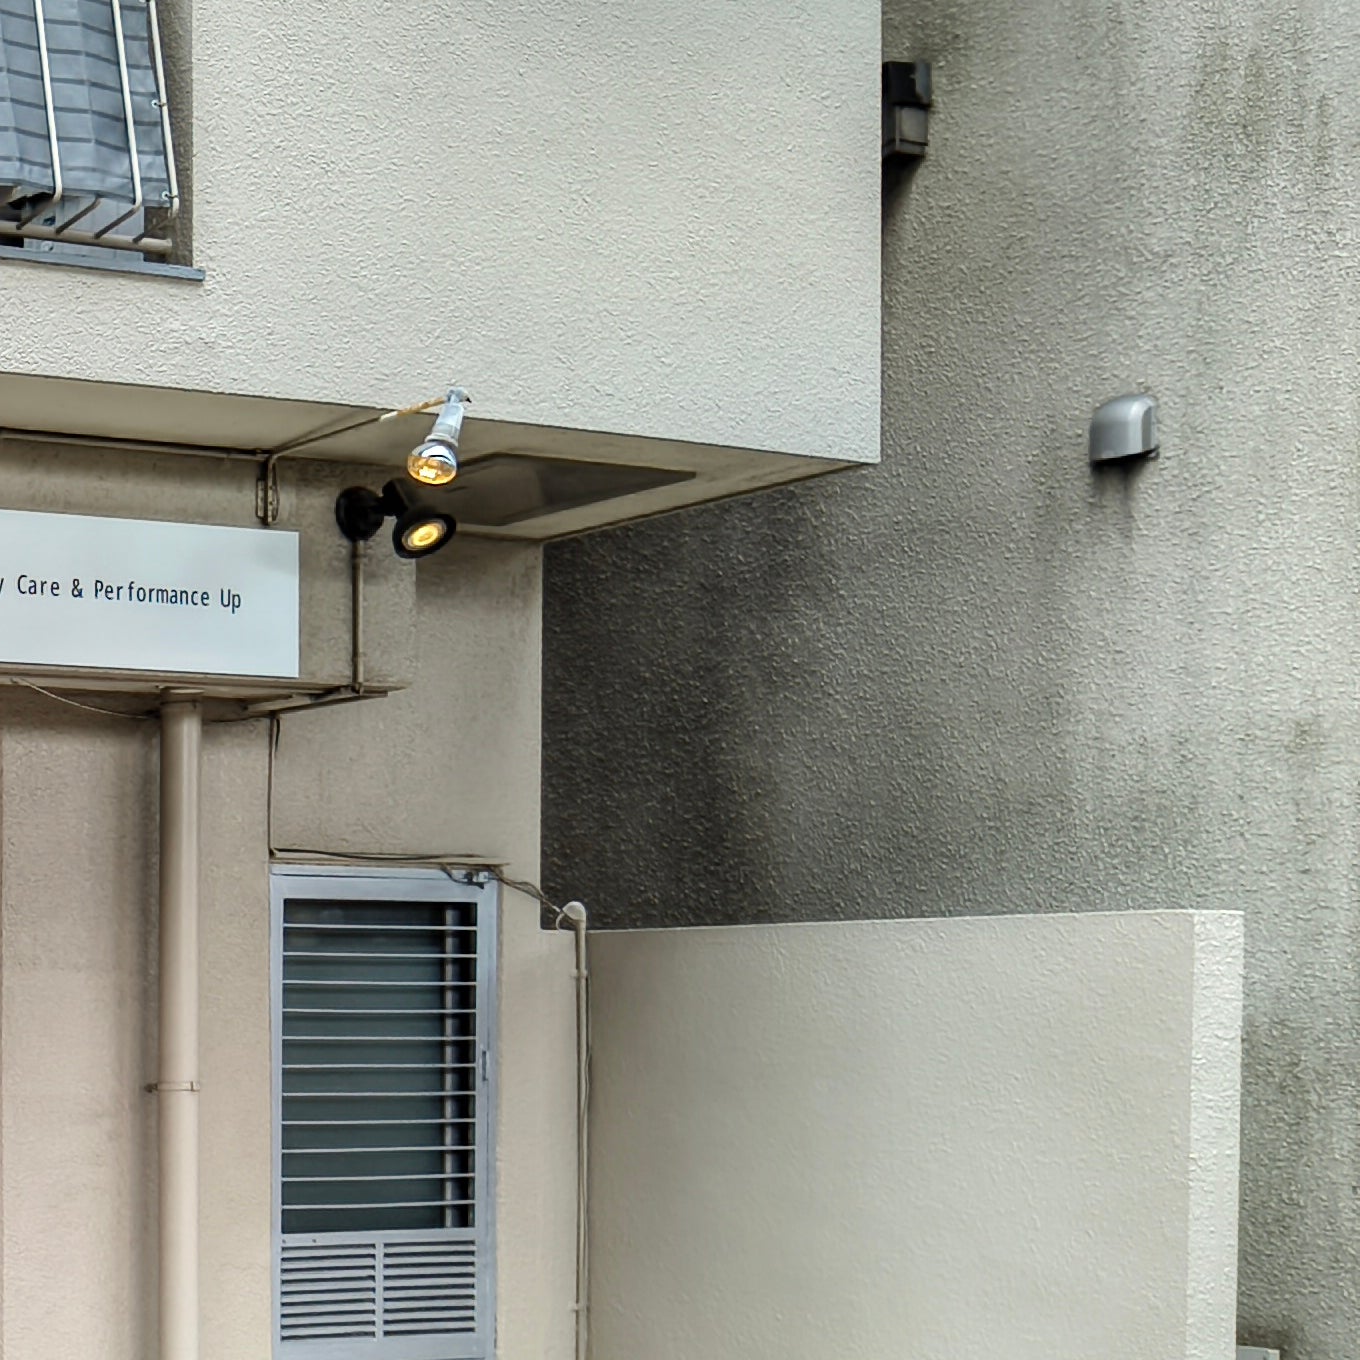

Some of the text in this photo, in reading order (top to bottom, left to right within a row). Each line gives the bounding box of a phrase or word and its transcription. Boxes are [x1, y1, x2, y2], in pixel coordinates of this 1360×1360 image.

[17, 574, 60, 597] Care
[72, 579, 84, 599] &
[94, 580, 211, 607] Performance
[221, 588, 242, 612] Up
